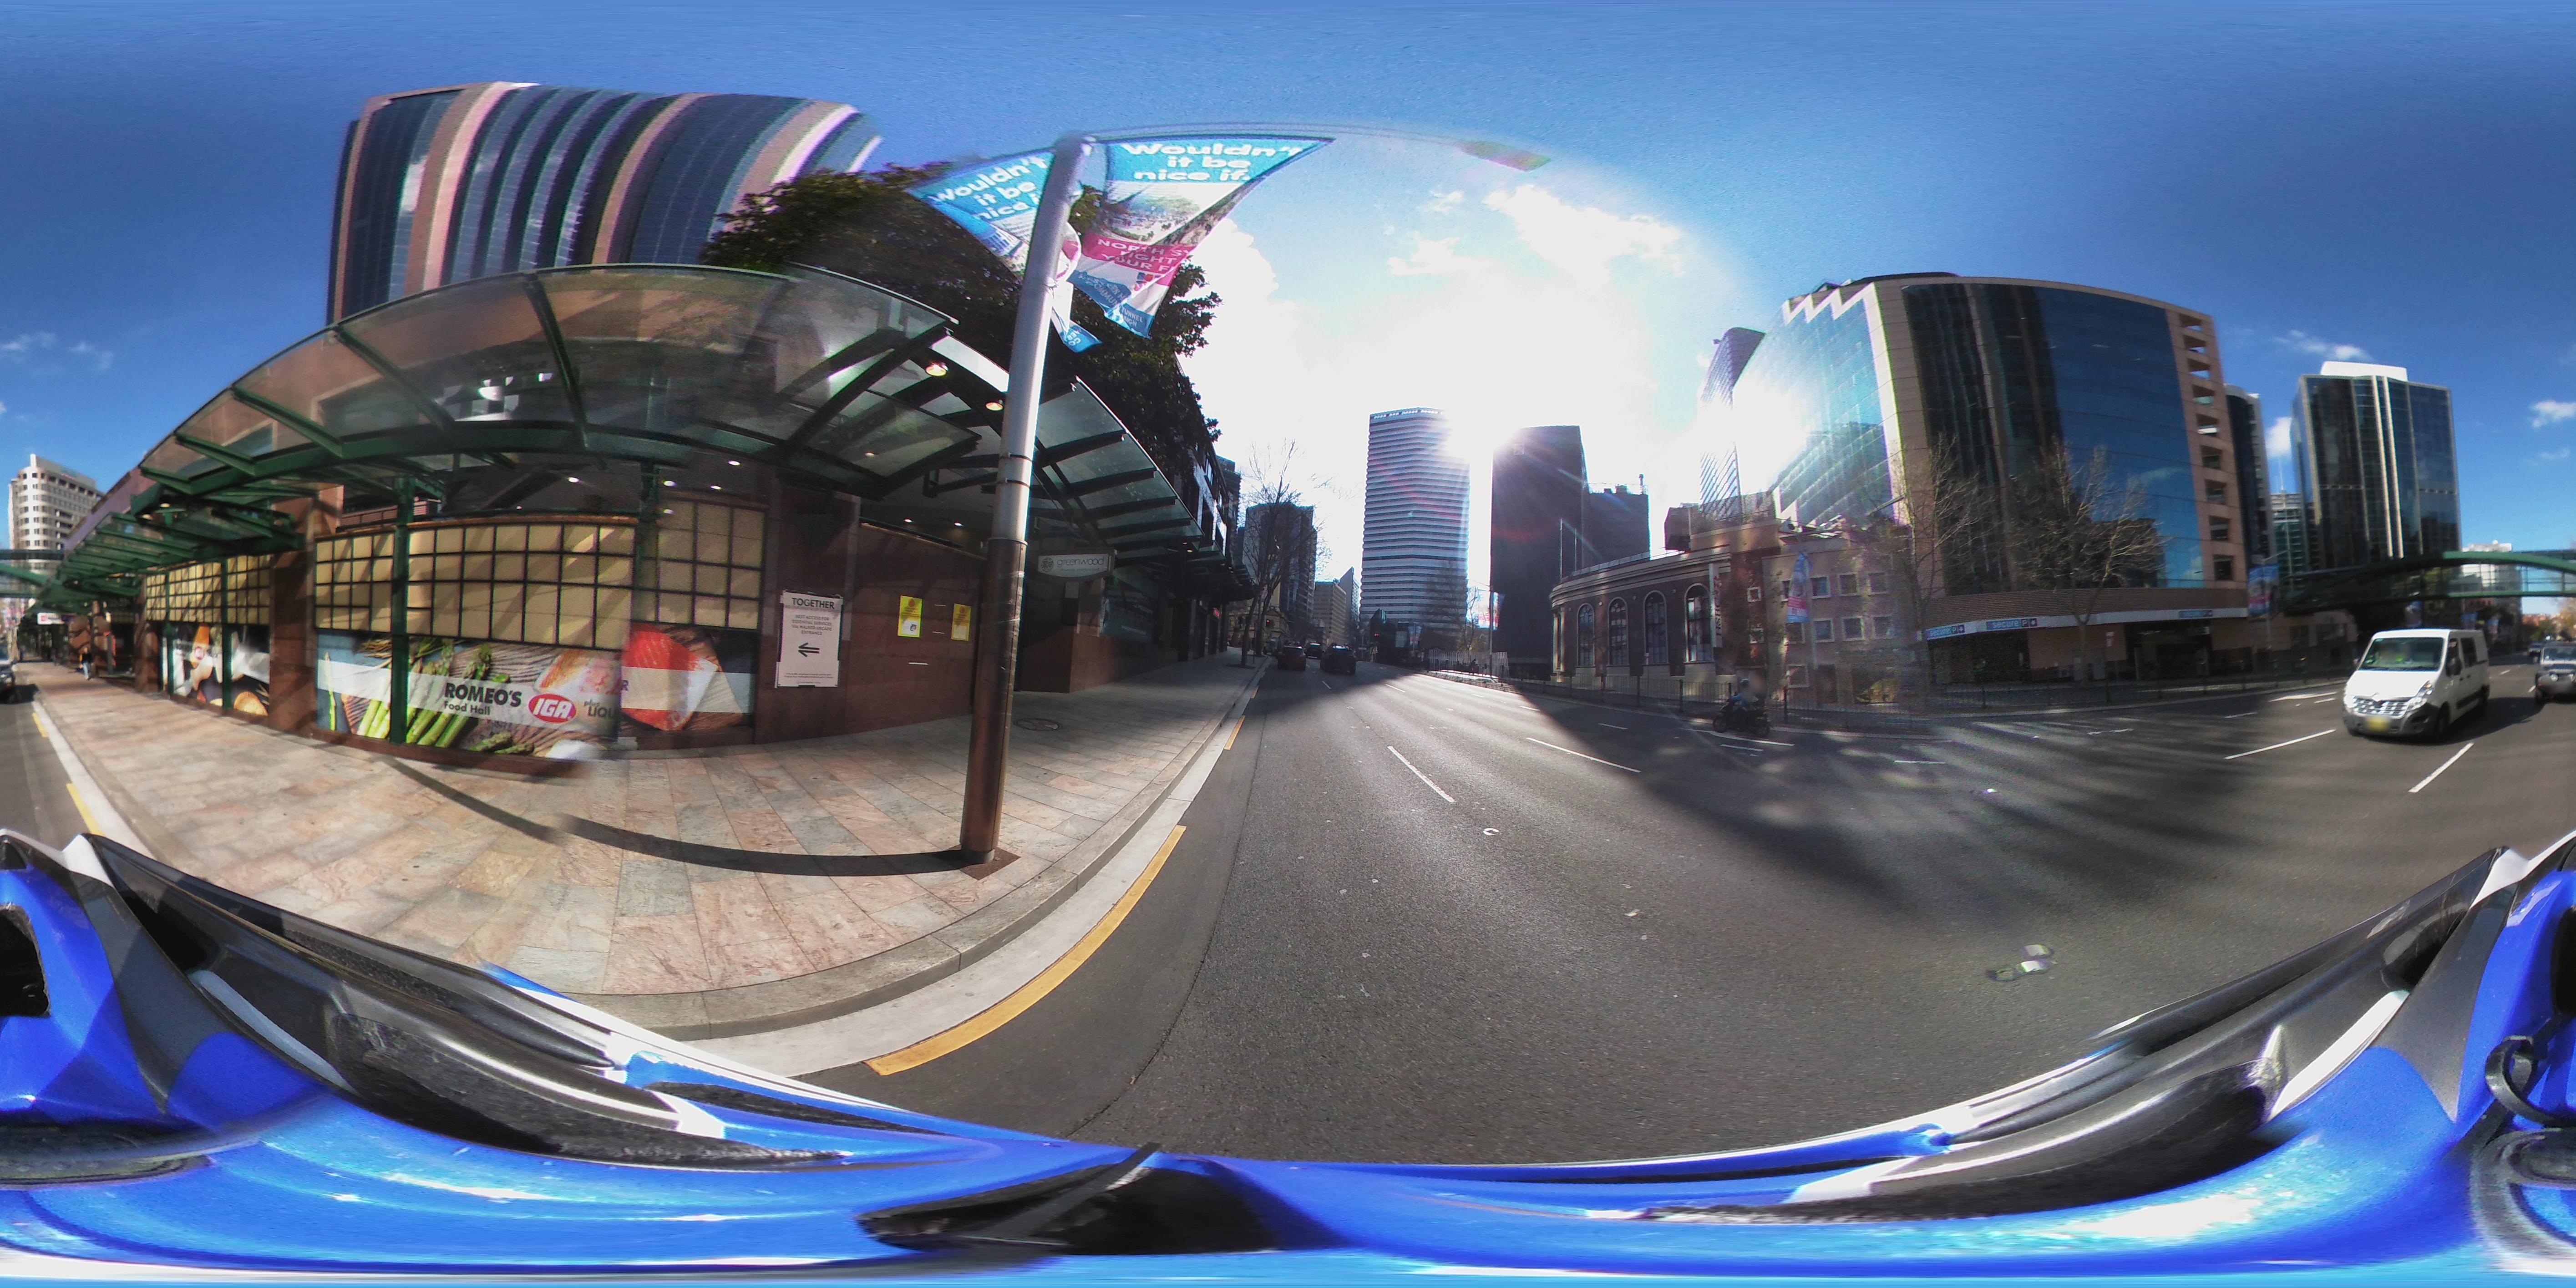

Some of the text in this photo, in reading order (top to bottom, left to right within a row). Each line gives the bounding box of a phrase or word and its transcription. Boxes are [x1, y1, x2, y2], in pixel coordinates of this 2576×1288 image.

[1166, 156, 1252, 168] it be
[1134, 169, 1211, 181] nice
[974, 182, 1037, 206] it be
[977, 201, 1029, 219] nice
[1097, 239, 1166, 255] NORTH
[1101, 254, 1152, 269] YOUR
[1056, 557, 1105, 568] greenwood
[791, 597, 835, 609] TOGETHER
[444, 683, 522, 707] ROMEO'S
[444, 701, 491, 715] Food Hall
[532, 698, 572, 719] IGA
